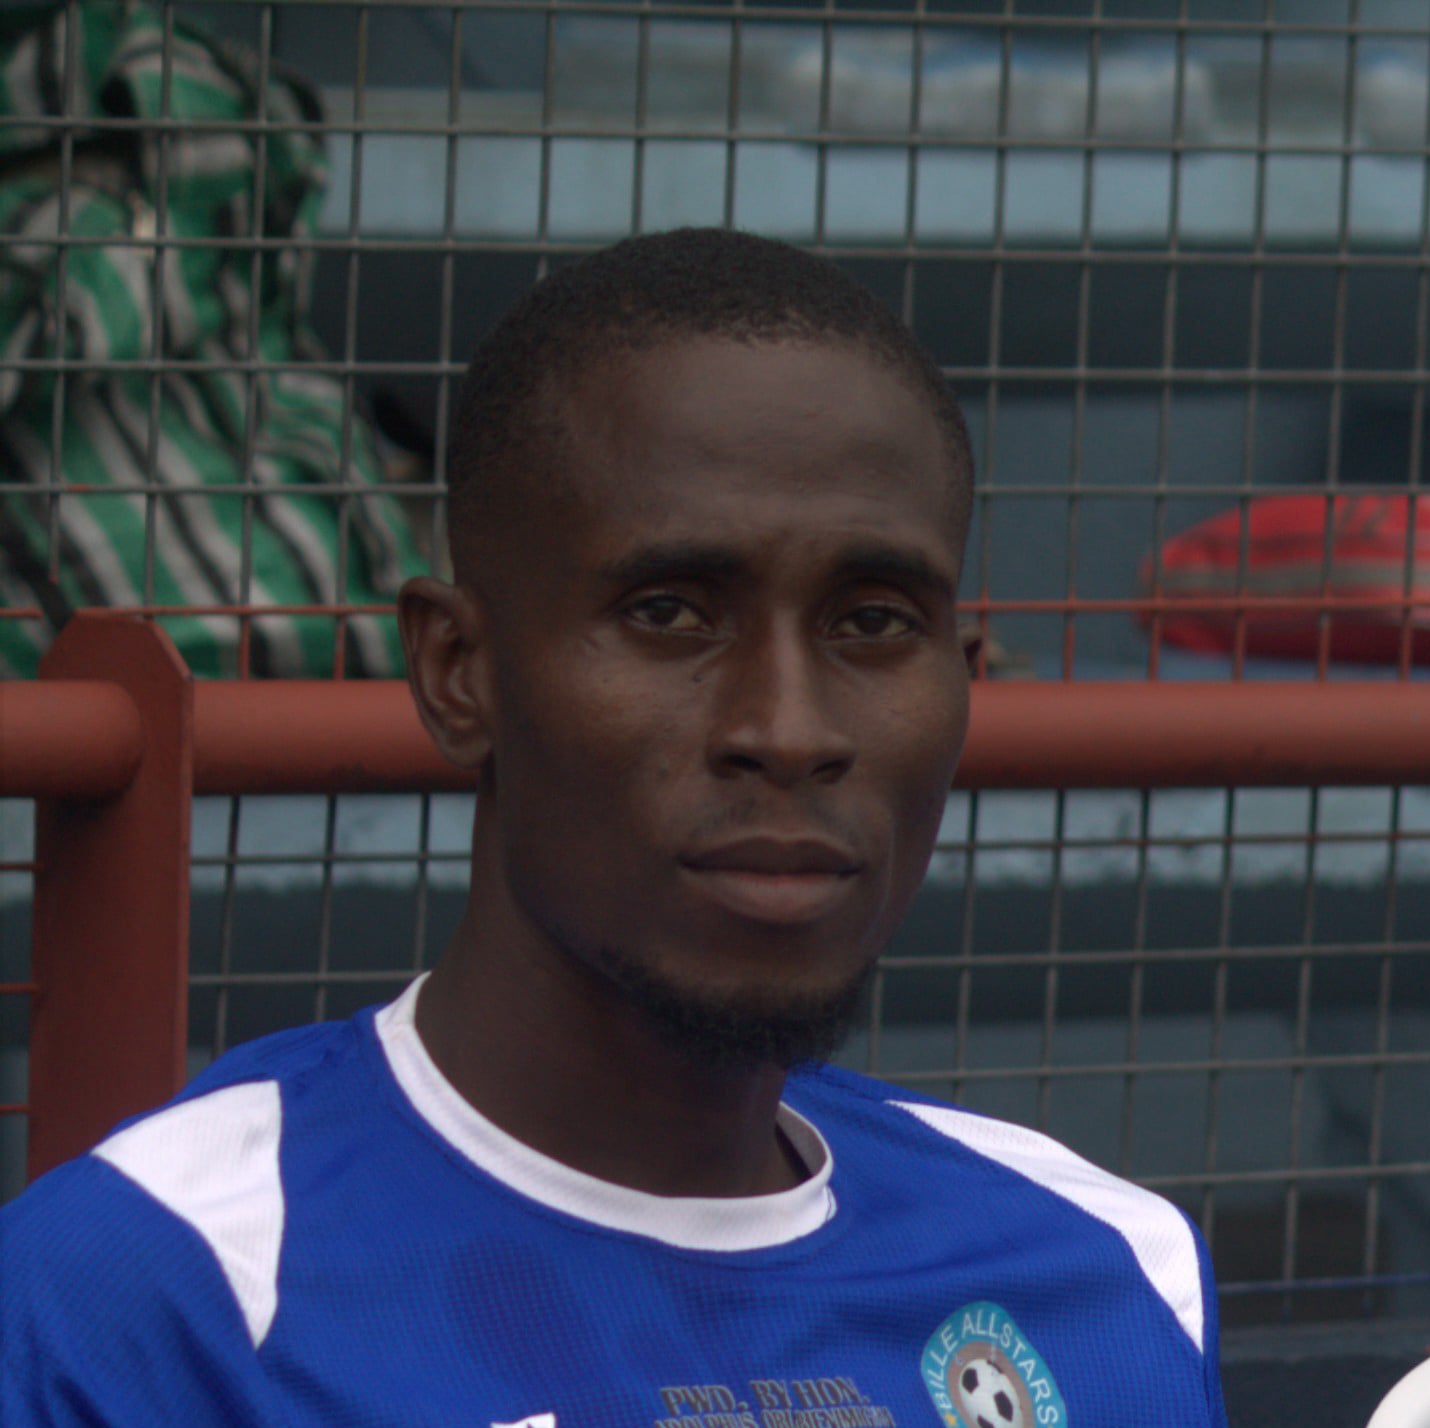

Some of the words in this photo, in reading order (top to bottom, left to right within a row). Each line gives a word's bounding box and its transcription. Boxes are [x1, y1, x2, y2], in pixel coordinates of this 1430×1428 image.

[659, 1384, 749, 1417] PWD.
[750, 1379, 793, 1409] BY
[791, 1376, 871, 1408] HON.
[928, 1325, 958, 1411] BILLE
[961, 1309, 1060, 1426] ALLSTARS
